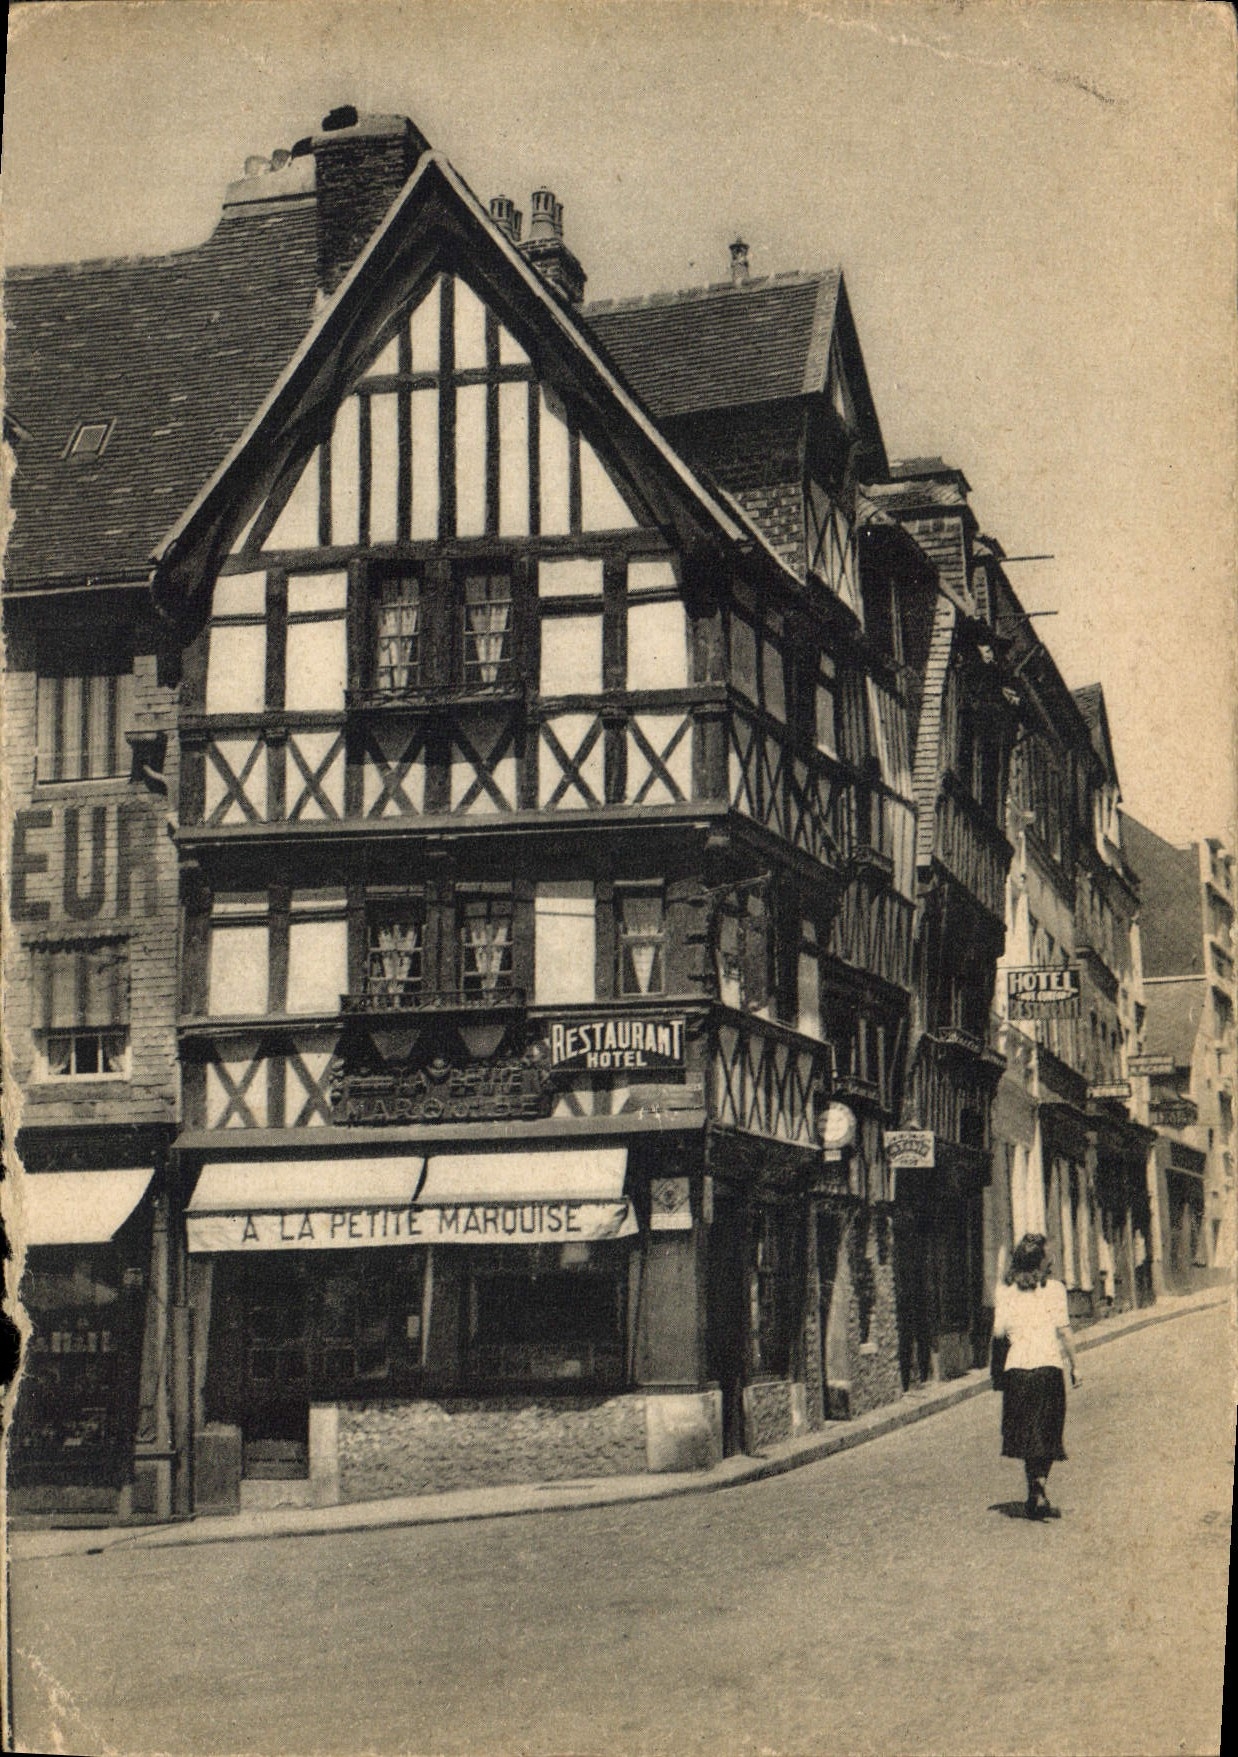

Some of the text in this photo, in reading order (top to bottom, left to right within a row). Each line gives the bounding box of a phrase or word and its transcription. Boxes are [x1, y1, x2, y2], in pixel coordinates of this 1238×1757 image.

[1009, 971, 1079, 995] HOTEL
[552, 1020, 683, 1067] RESTAURANT
[586, 1051, 647, 1068] HOTEL
[242, 1202, 582, 1242] A LA PETITE MARQUISE
